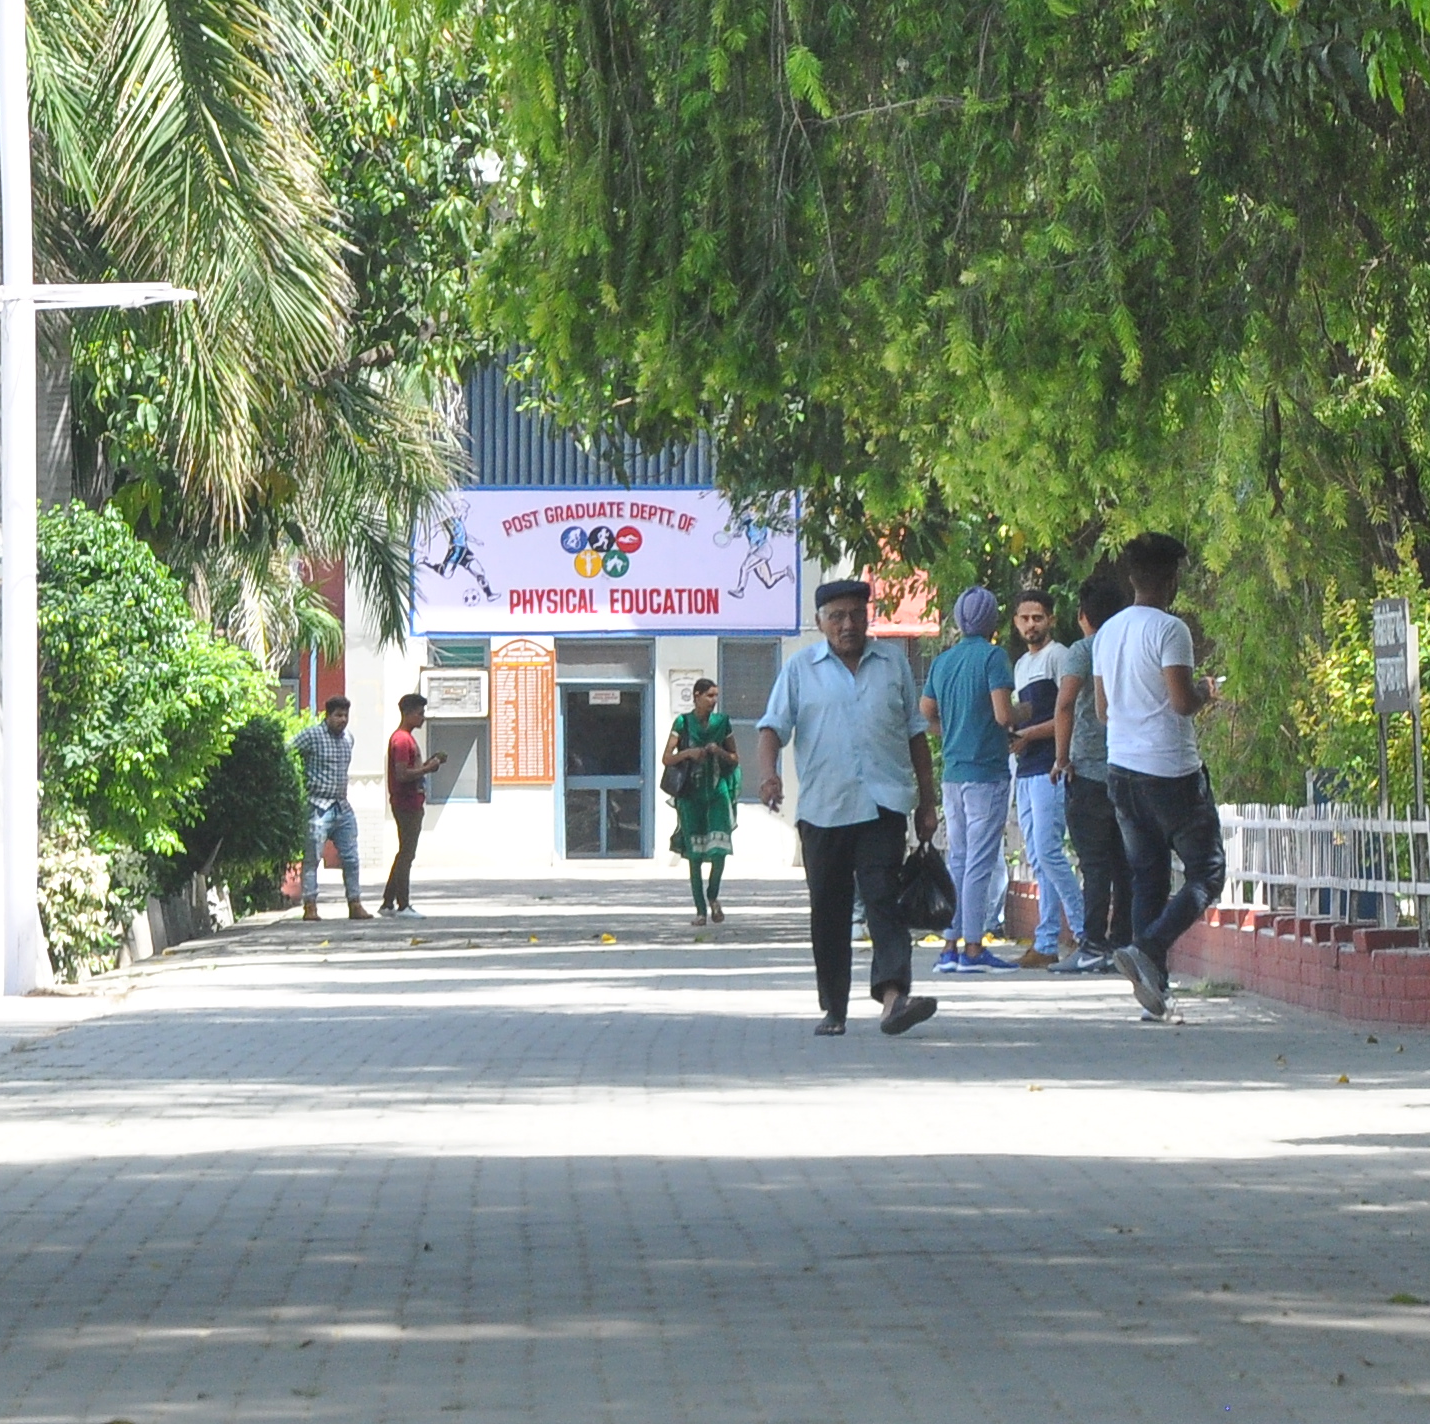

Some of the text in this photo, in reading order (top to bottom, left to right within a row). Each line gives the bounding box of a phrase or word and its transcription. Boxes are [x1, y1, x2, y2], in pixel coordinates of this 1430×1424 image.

[502, 502, 697, 536] POST GRADUATE DEPTT. OF
[509, 588, 719, 615] PHYSICAL EDUCATION
